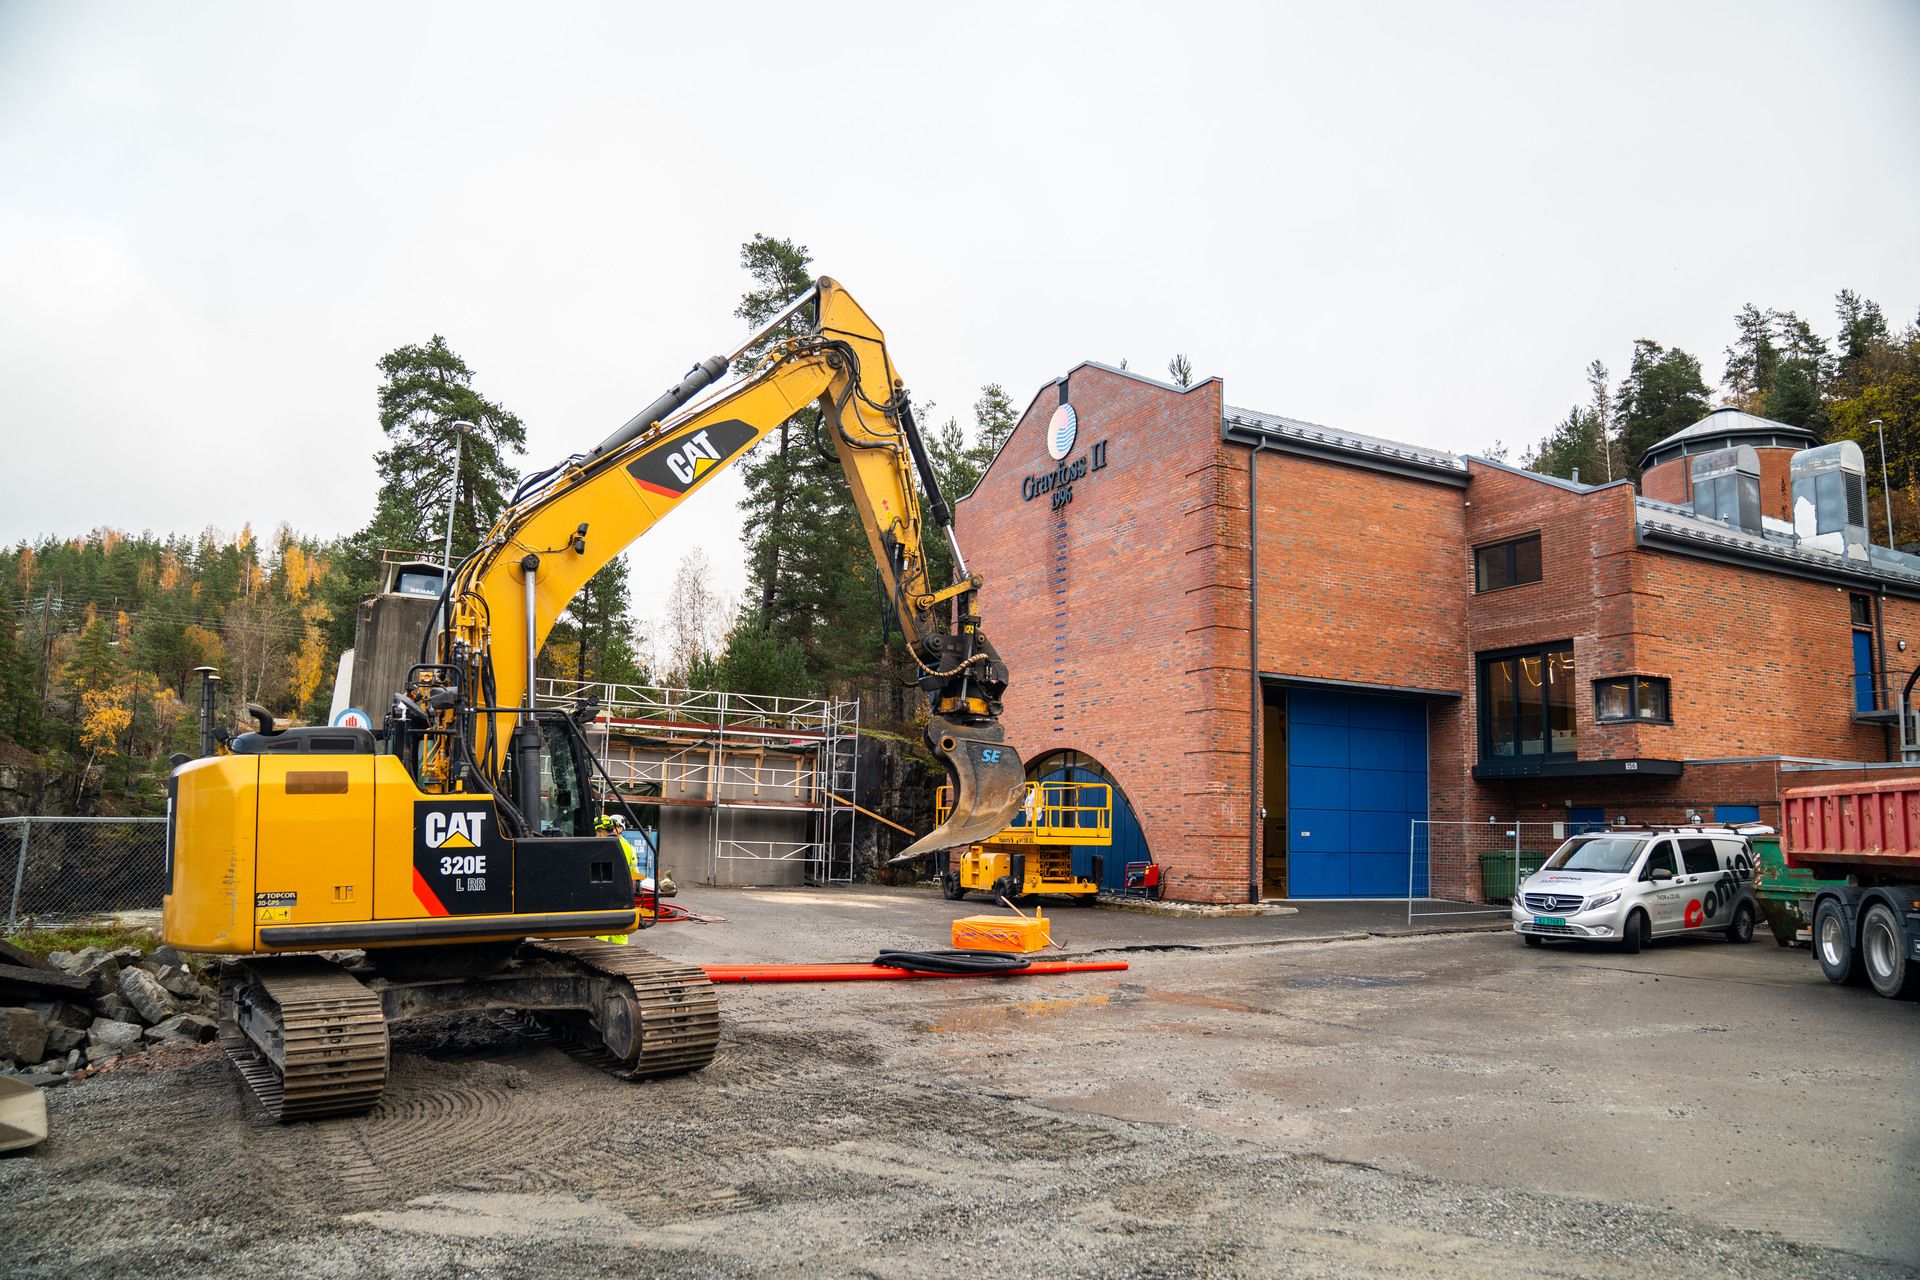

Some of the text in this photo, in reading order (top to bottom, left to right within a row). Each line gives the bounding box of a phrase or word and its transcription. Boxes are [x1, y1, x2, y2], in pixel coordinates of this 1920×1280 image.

[666, 430, 721, 484] CAT
[1021, 439, 1107, 501] Gravfoss II
[1051, 486, 1073, 511] 1996
[982, 749, 1001, 763] SE
[425, 811, 487, 849] CAT
[440, 856, 487, 875] 320E
[456, 878, 487, 892] L RR
